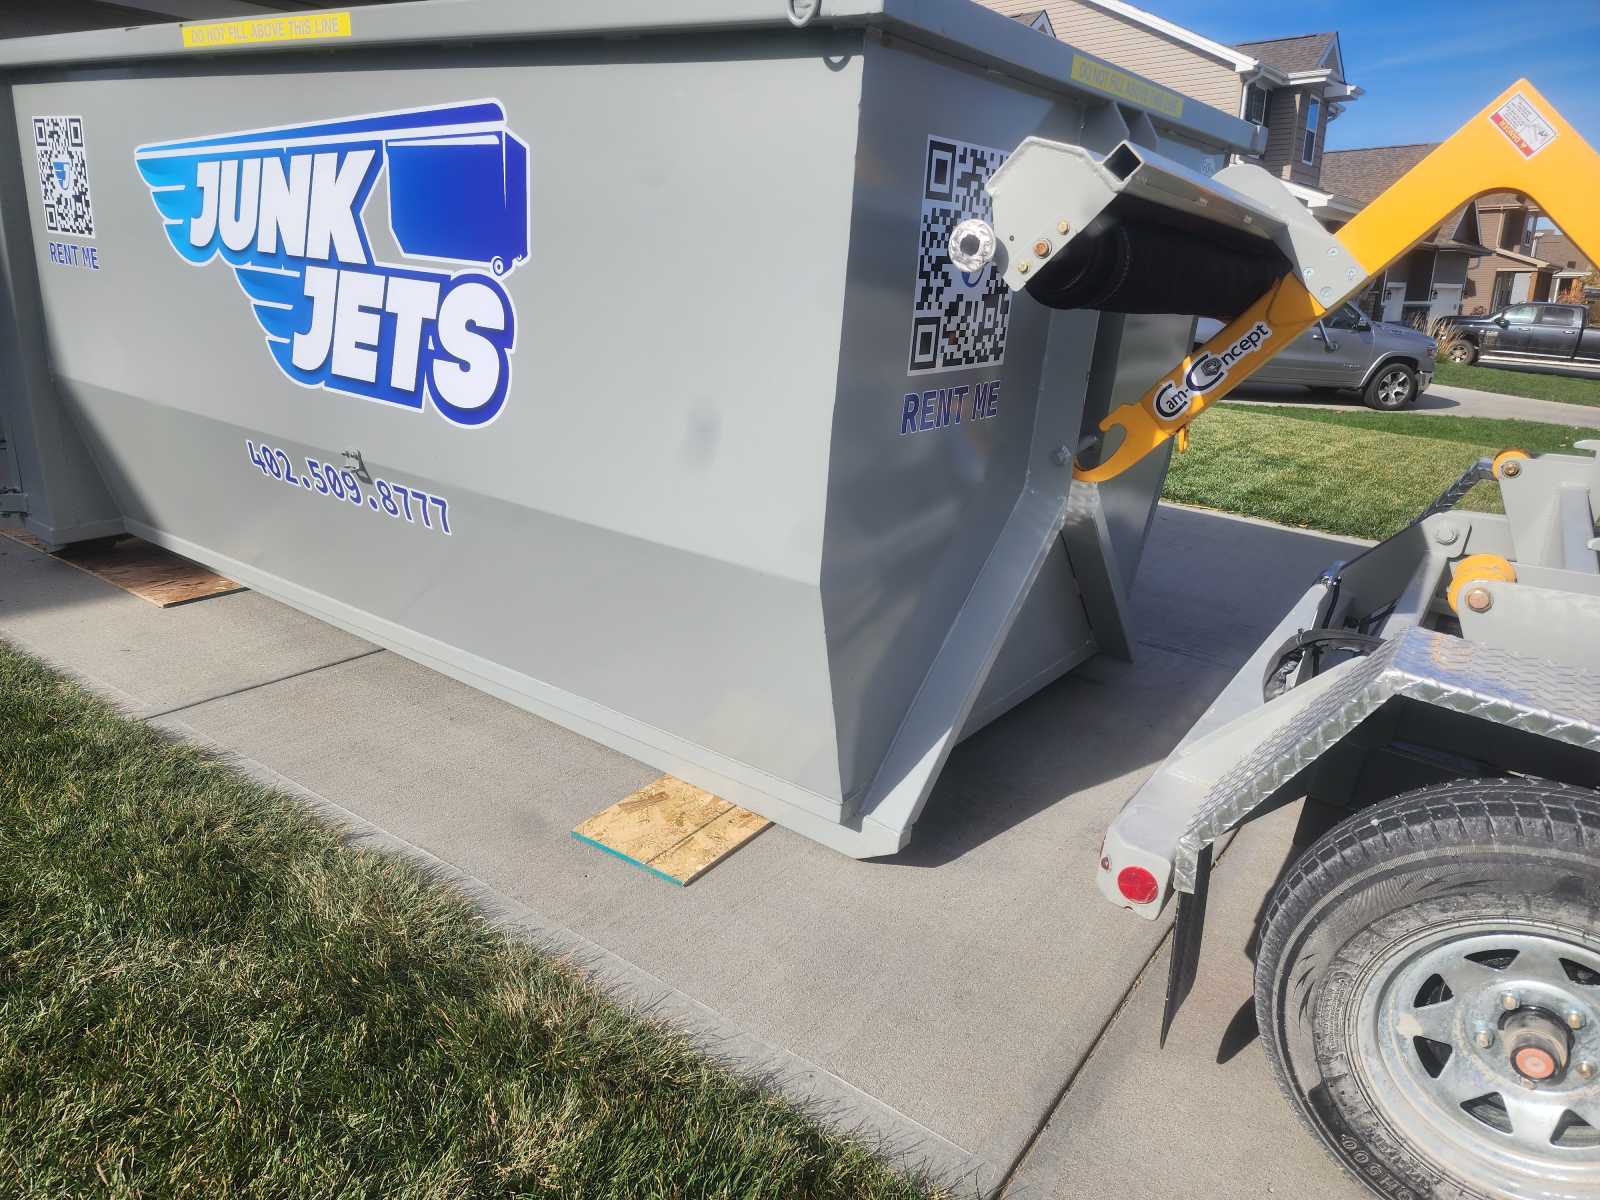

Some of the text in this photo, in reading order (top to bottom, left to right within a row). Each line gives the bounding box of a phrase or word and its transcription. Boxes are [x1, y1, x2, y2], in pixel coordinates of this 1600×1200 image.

[189, 149, 376, 265] JUNK
[48, 241, 100, 271] RENT ME
[291, 265, 506, 409] JETS
[900, 379, 1001, 435] RENT ME
[246, 439, 451, 536] 402.509.8777
